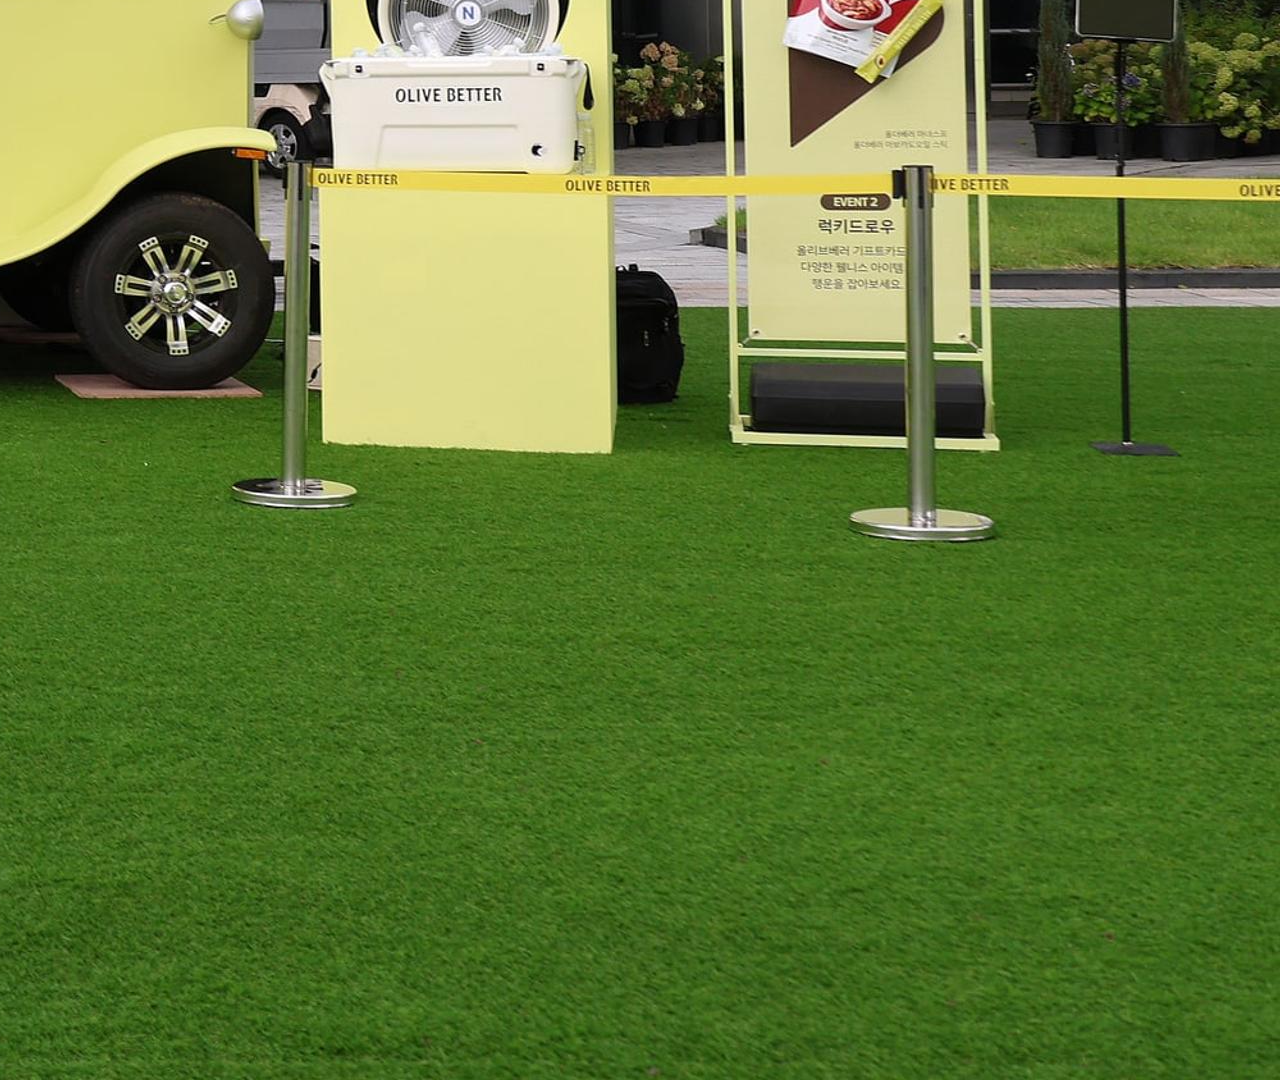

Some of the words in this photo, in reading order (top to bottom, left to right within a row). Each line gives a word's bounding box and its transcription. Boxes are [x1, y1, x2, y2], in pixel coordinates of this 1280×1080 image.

[463, 6, 474, 19] N
[395, 88, 441, 103] OLIVE
[447, 87, 502, 102] BETTER
[318, 173, 352, 184] OLIVE
[356, 173, 398, 185] BETTER
[565, 179, 602, 191] OLIVE
[606, 180, 650, 192] BETTER
[960, 178, 1009, 191] BETTER
[1240, 184, 1280, 197] OLIVE
[834, 197, 867, 208] EVENT
[869, 196, 878, 207] 2
[818, 219, 895, 234] 럭키드로우
[797, 245, 850, 257] 올리브베러
[852, 245, 907, 257] 기프트카드
[801, 261, 832, 274] 다양한
[870, 261, 904, 274] 아이템
